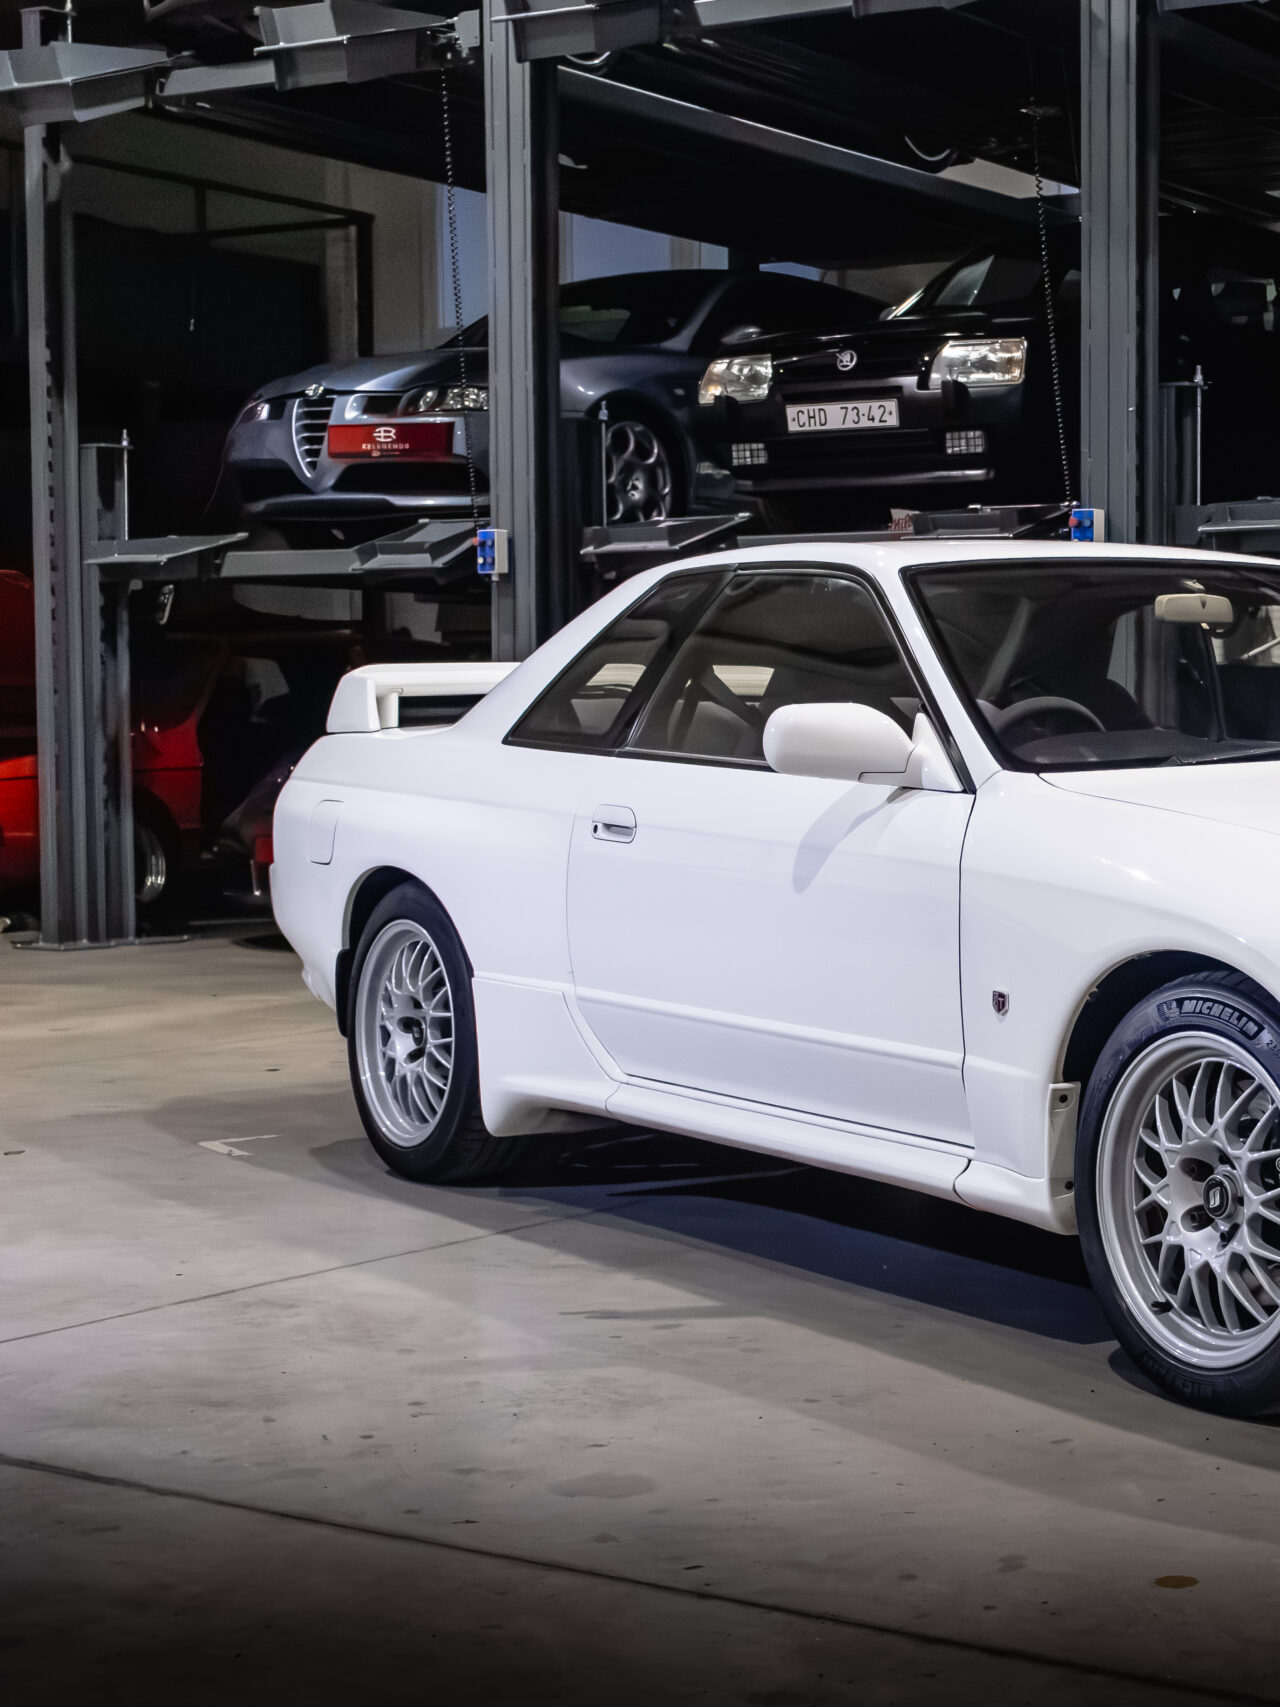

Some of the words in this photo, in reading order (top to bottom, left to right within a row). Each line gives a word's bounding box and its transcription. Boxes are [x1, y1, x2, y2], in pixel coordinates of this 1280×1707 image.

[796, 408, 828, 427] CHD
[839, 405, 887, 425] 73-42
[1181, 1000, 1258, 1037] MICHELIN
